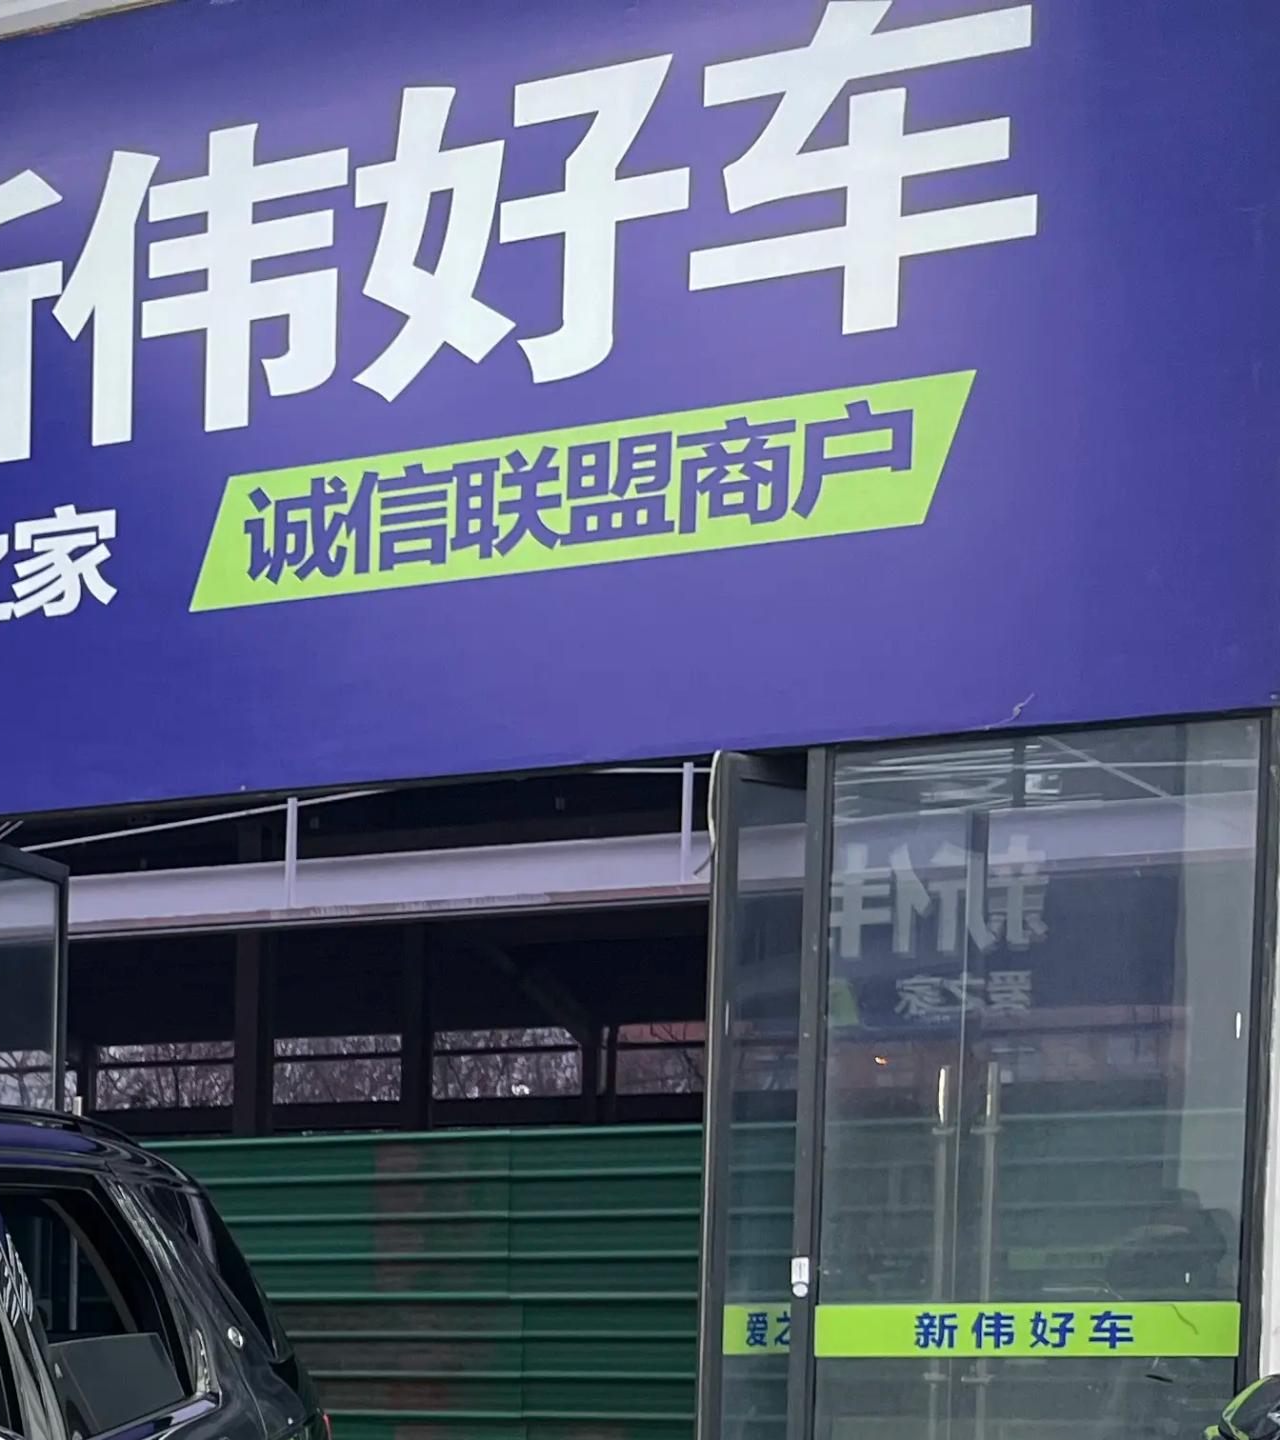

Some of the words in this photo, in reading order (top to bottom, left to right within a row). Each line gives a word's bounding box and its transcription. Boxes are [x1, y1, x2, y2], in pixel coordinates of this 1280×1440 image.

[242, 398, 916, 585] 诚信联盟商户
[913, 1310, 1135, 1350] 新伟好车
